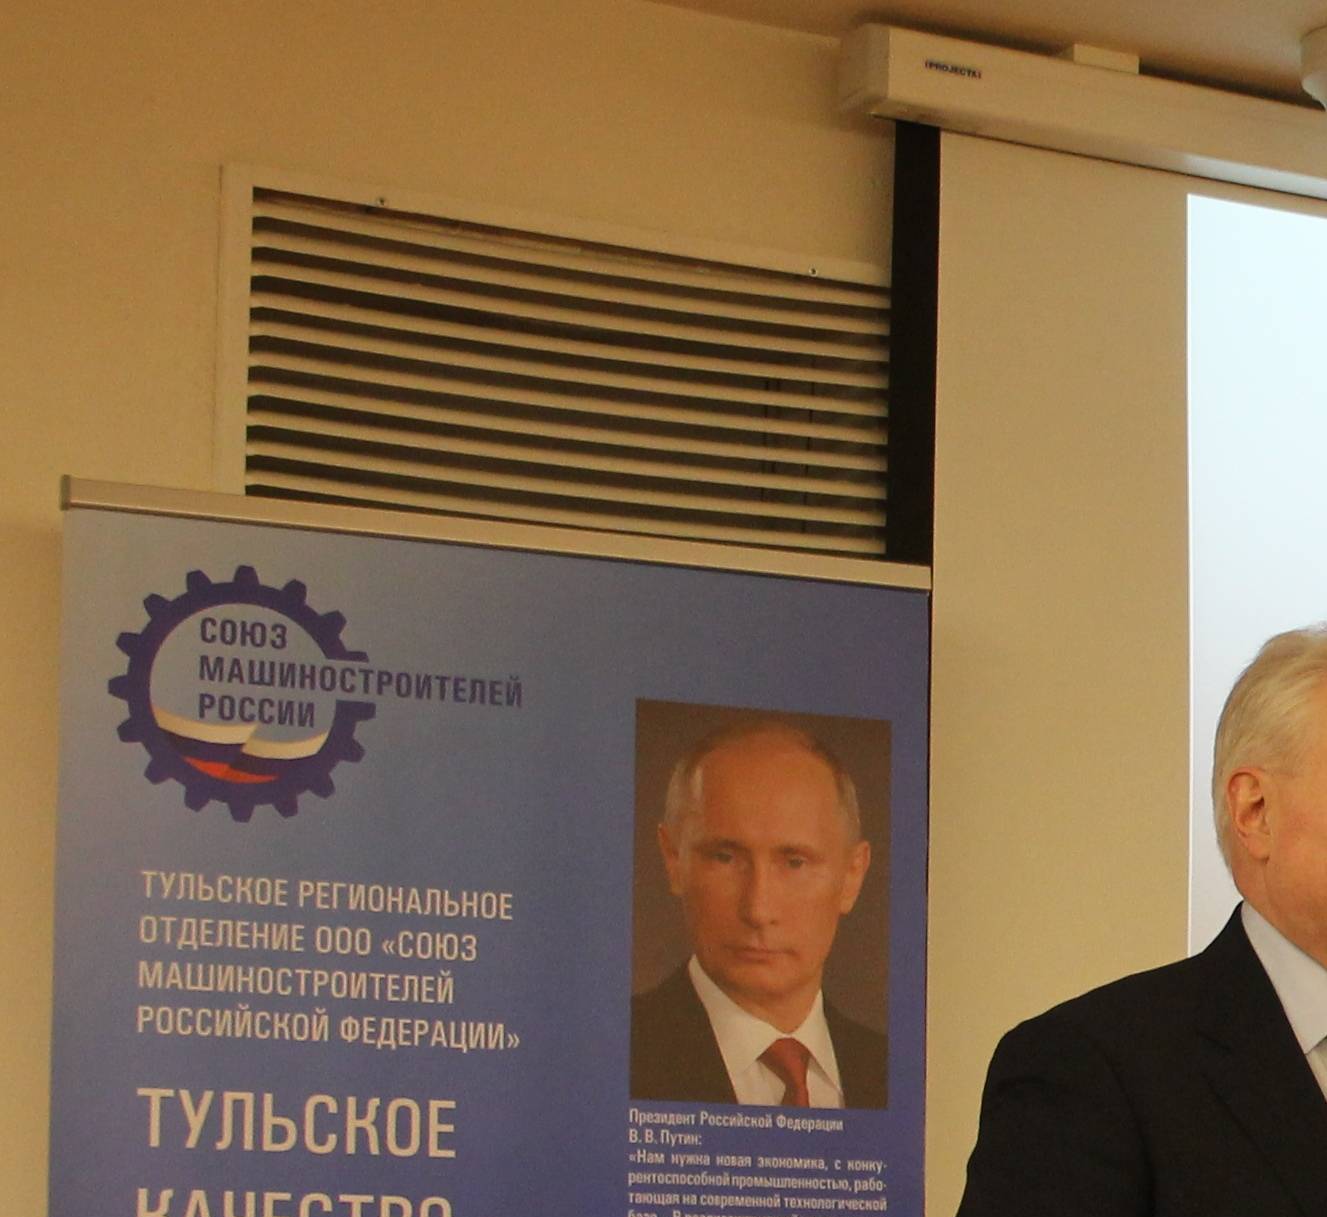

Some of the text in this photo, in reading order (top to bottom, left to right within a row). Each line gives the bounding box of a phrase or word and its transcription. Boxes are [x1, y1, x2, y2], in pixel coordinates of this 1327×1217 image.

[200, 616, 287, 650] СОЮЗ
[199, 654, 523, 708] МАШИНОСТРОИТЕЛЕЙ
[199, 692, 315, 728] РОССИИ
[141, 870, 513, 921] ТУЛЬСКОЕ РЕГИОНАЛЬНОЕ
[139, 915, 477, 961] ОТДЕЛЕНИЕ ООО «СОЮЗ
[138, 960, 454, 1004] МАШИНОСТРОИТЕЛЕЙ
[137, 1003, 520, 1054] РОССИЙСКОЙ ФЕДЕРАЦИИ»
[137, 1087, 456, 1158] ТУЛЬСКОЕ
[629, 1108, 844, 1133] Президент Российской Федерации
[629, 1129, 702, 1147] В. В. Путин:
[629, 1149, 888, 1174] «Нам нужна новая экономика, с конку-
[628, 1171, 887, 1193] рентоспособной промышленностью, рабо-
[629, 1193, 887, 1210] тающая на современной технологической
